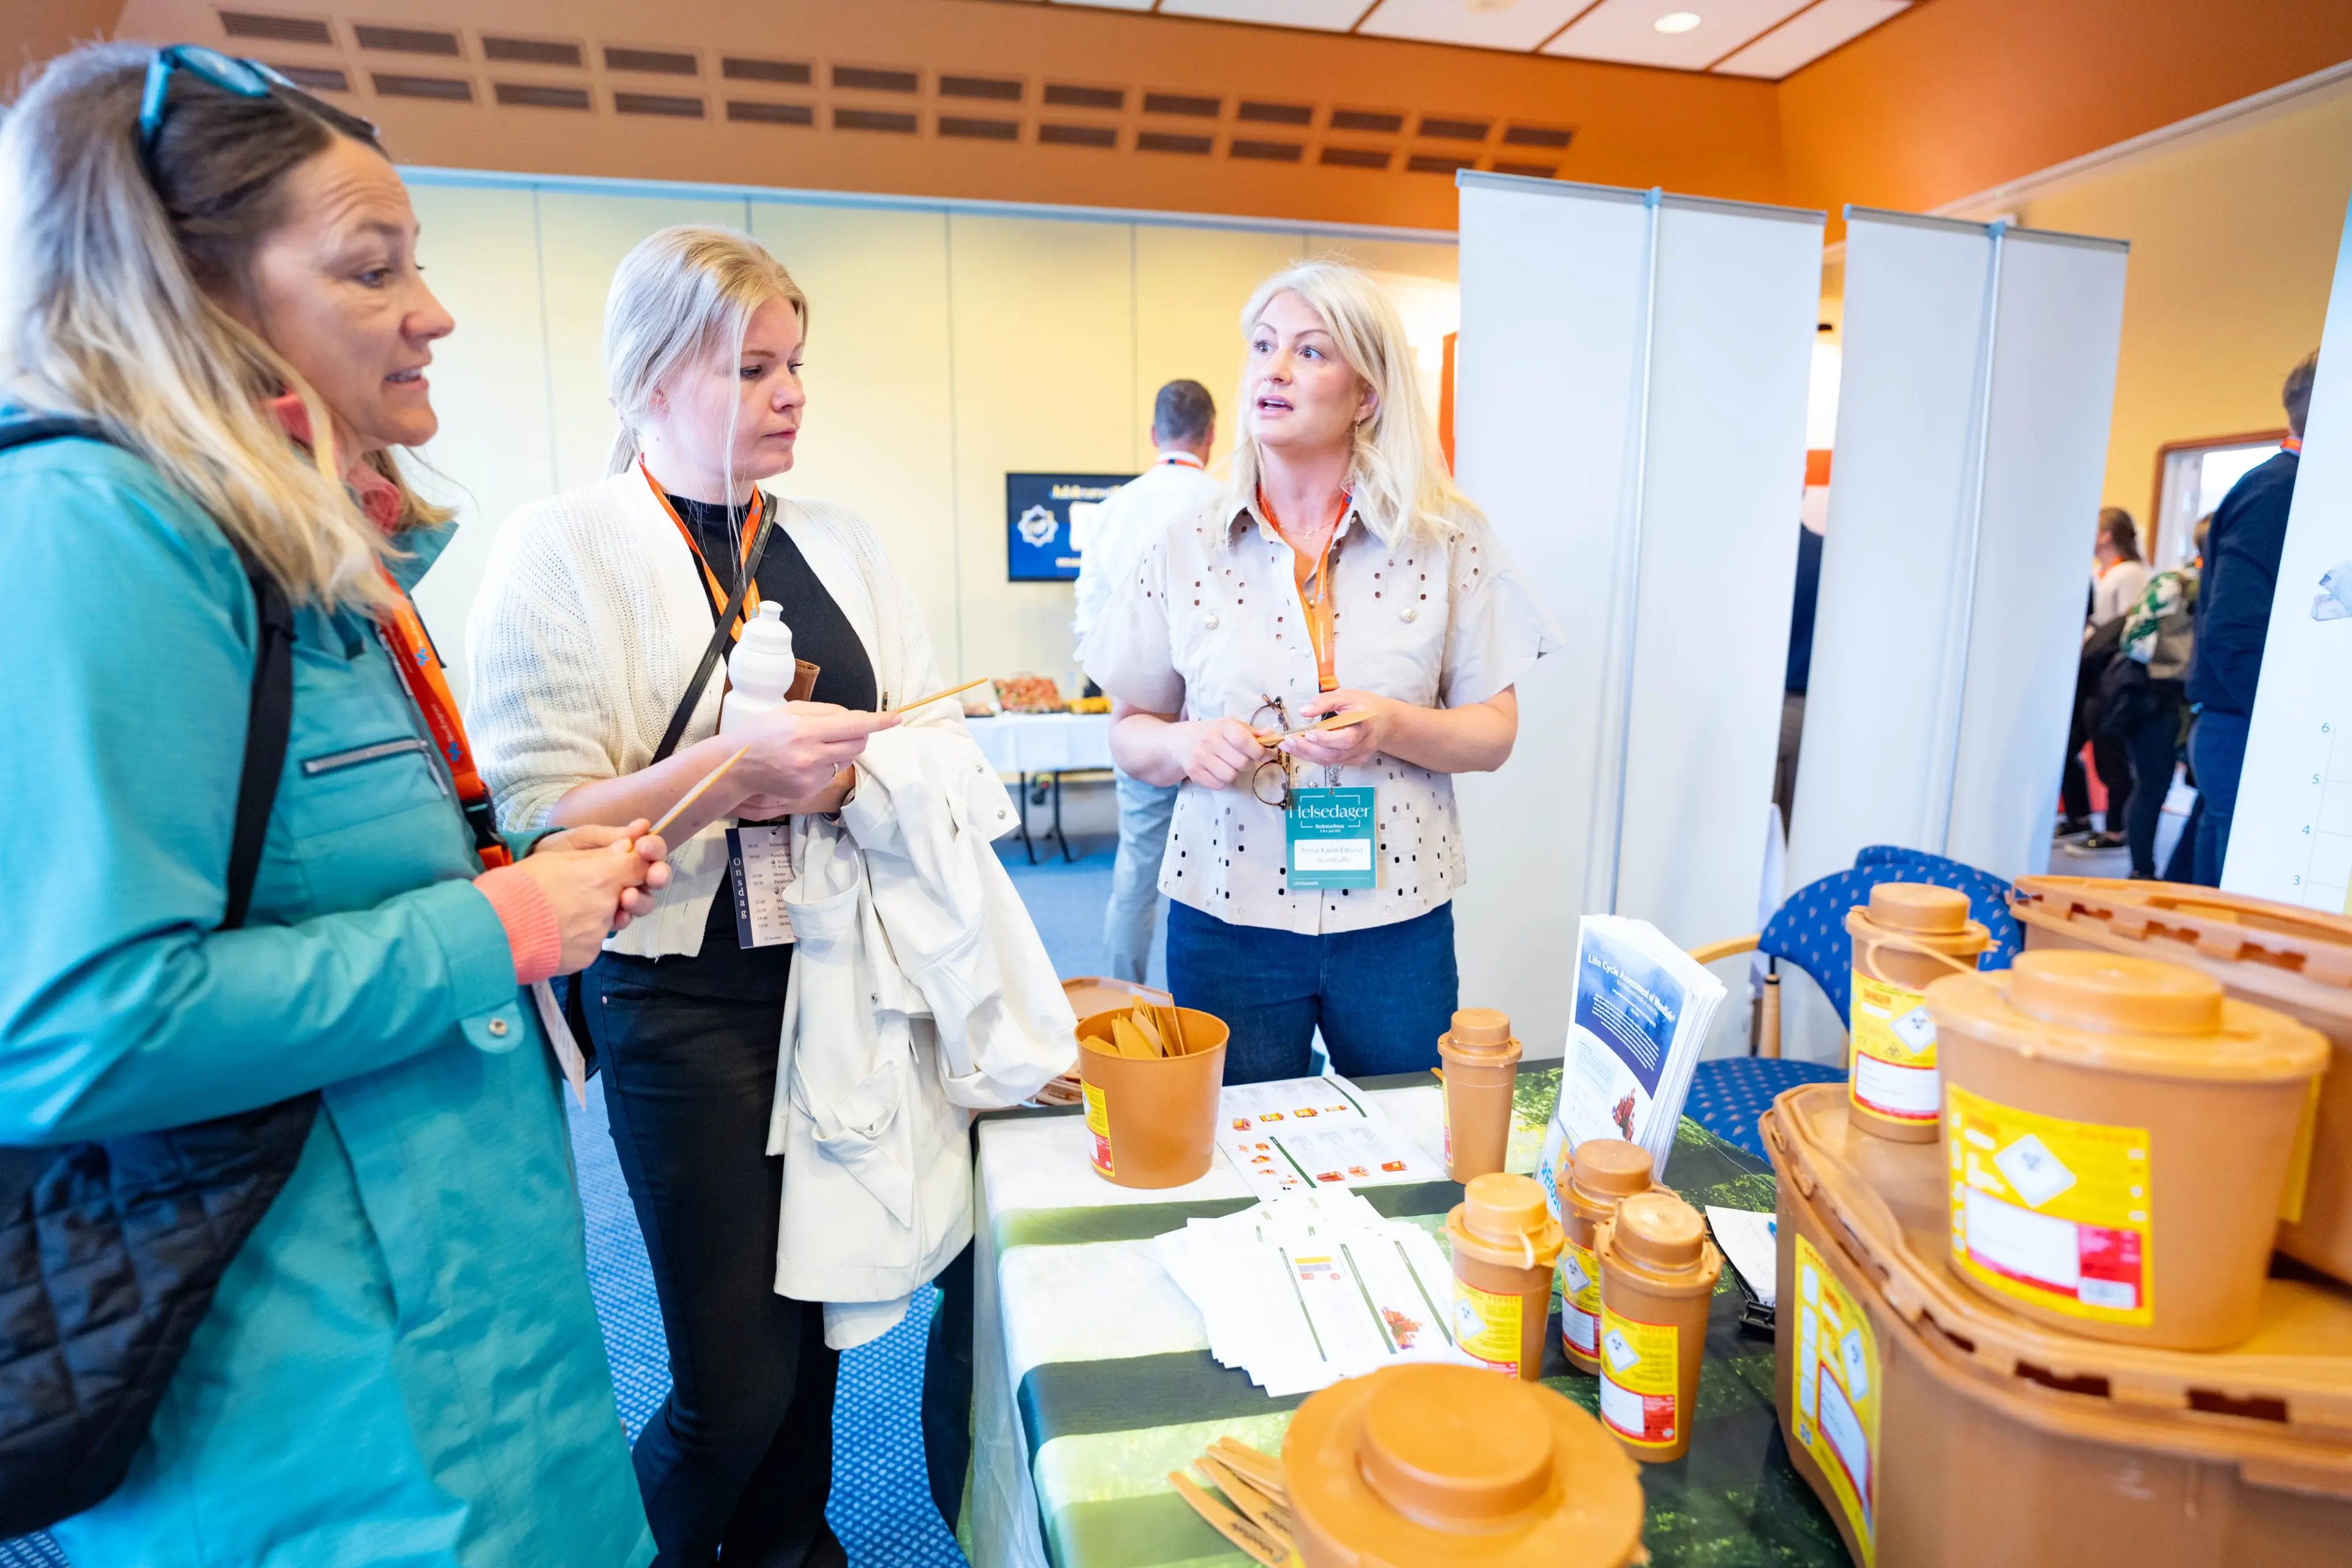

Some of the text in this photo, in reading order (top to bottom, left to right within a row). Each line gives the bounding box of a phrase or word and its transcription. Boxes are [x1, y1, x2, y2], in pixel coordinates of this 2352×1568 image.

[2322, 722, 2329, 733] 6
[2312, 774, 2320, 784] 5
[1289, 804, 1370, 821] Helsedager
[2302, 824, 2310, 835] 4
[2293, 875, 2301, 886] 3
[733, 858, 747, 919] Onsdag
[1588, 954, 1602, 968] Life
[1602, 960, 1619, 978] Cycle
[1619, 970, 1649, 999] Assessment
